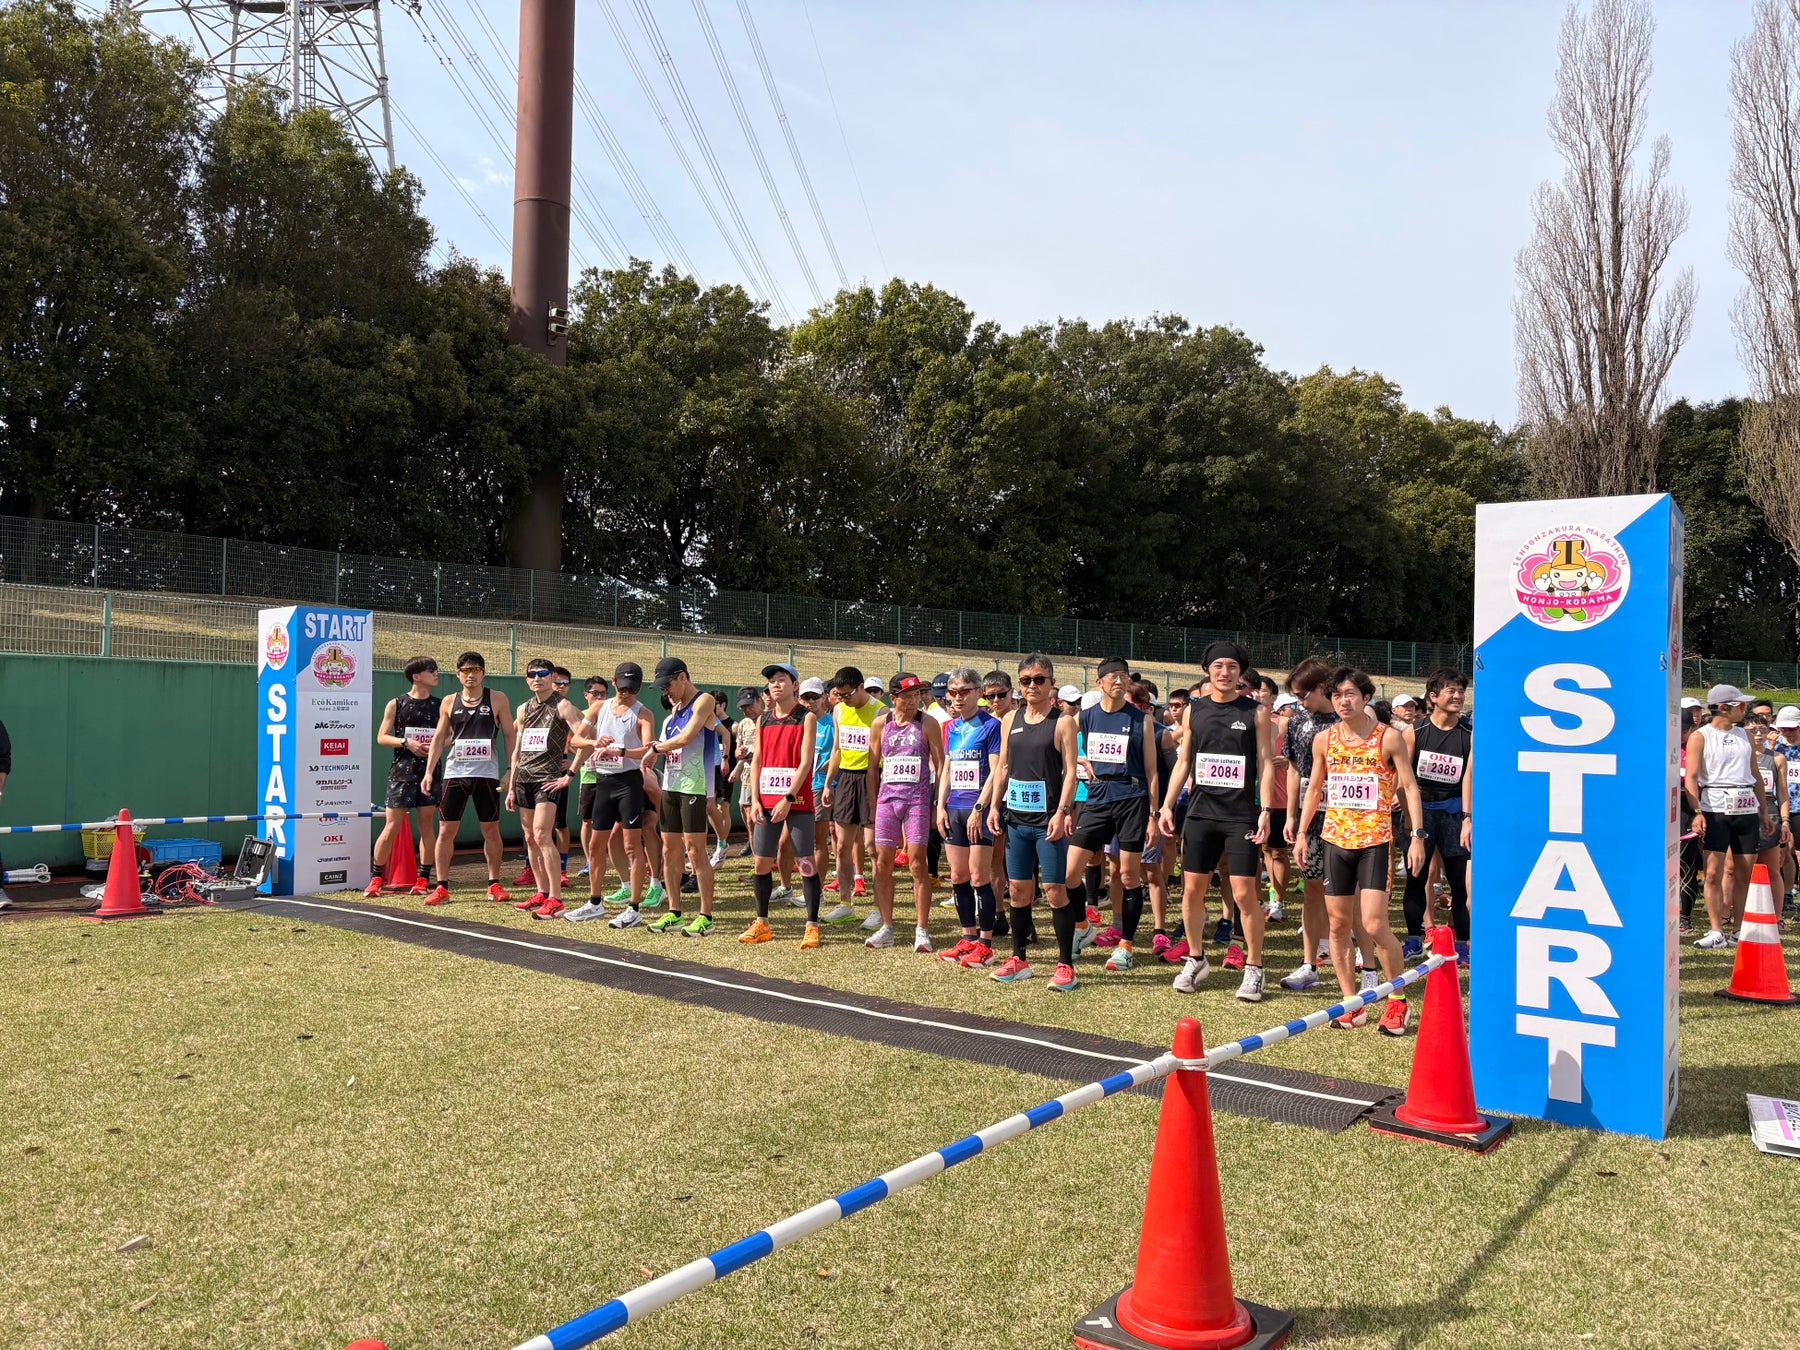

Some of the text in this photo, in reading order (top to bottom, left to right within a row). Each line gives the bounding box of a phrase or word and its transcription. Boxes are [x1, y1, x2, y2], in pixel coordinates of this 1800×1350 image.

[1513, 525, 1581, 567] SENBONZAKURA
[1586, 526, 1628, 566] MARATHON
[1522, 593, 1613, 606] HONJO-KODAMA
[305, 612, 366, 641] START
[848, 733, 866, 745] 2145
[466, 746, 487, 756] 2246
[1099, 743, 1122, 755] 2554
[1429, 753, 1453, 763] OKI
[320, 764, 360, 772] TECHNOPLAN
[893, 764, 916, 775] 2848
[1210, 764, 1239, 779] 2084
[1430, 762, 1457, 776] 2389
[769, 776, 792, 788] 2218
[954, 770, 975, 782] 2809
[264, 683, 288, 884] START
[1010, 789, 1041, 803] 金 哲彦
[1341, 784, 1371, 800] 2051
[1737, 797, 1756, 809] 2245
[323, 835, 344, 843] OKI
[324, 873, 343, 881] CAINZ
[1509, 662, 1624, 1105] START
